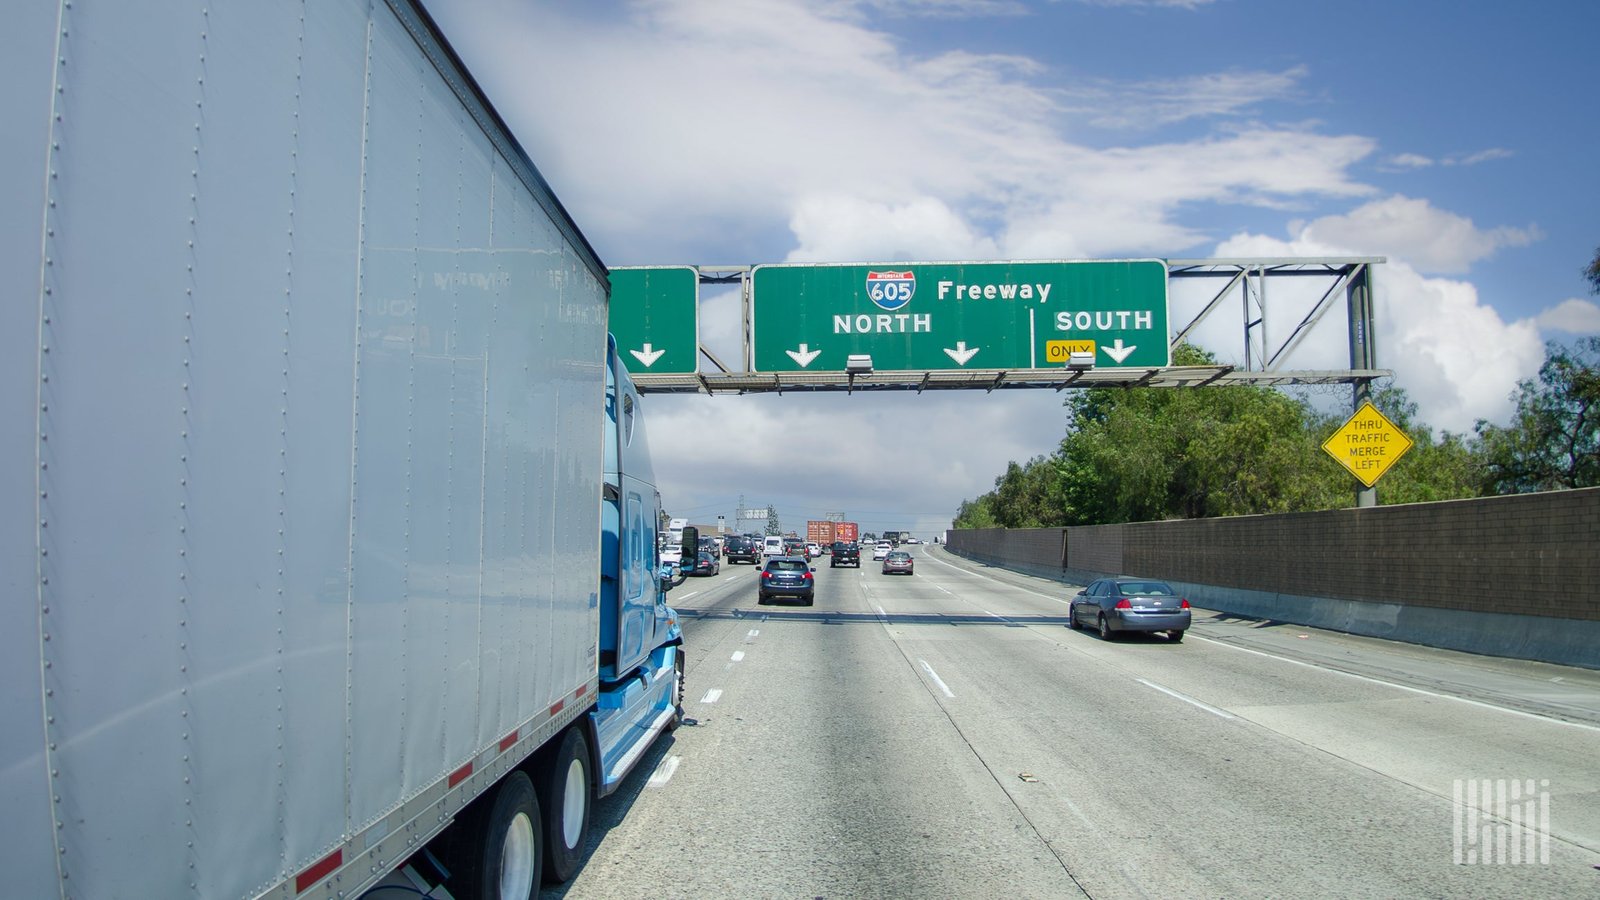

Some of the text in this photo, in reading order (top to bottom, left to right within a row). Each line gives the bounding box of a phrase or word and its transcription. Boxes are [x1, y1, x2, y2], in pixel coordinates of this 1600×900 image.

[871, 281, 1051, 303] 605 Freeway
[834, 314, 931, 333] NORTH
[1057, 311, 1151, 330] SOUTH
[1354, 420, 1382, 429] THRU
[1346, 433, 1390, 443] TRAFFIC
[1350, 447, 1386, 456] MERGE
[1355, 460, 1381, 469] LEFT
